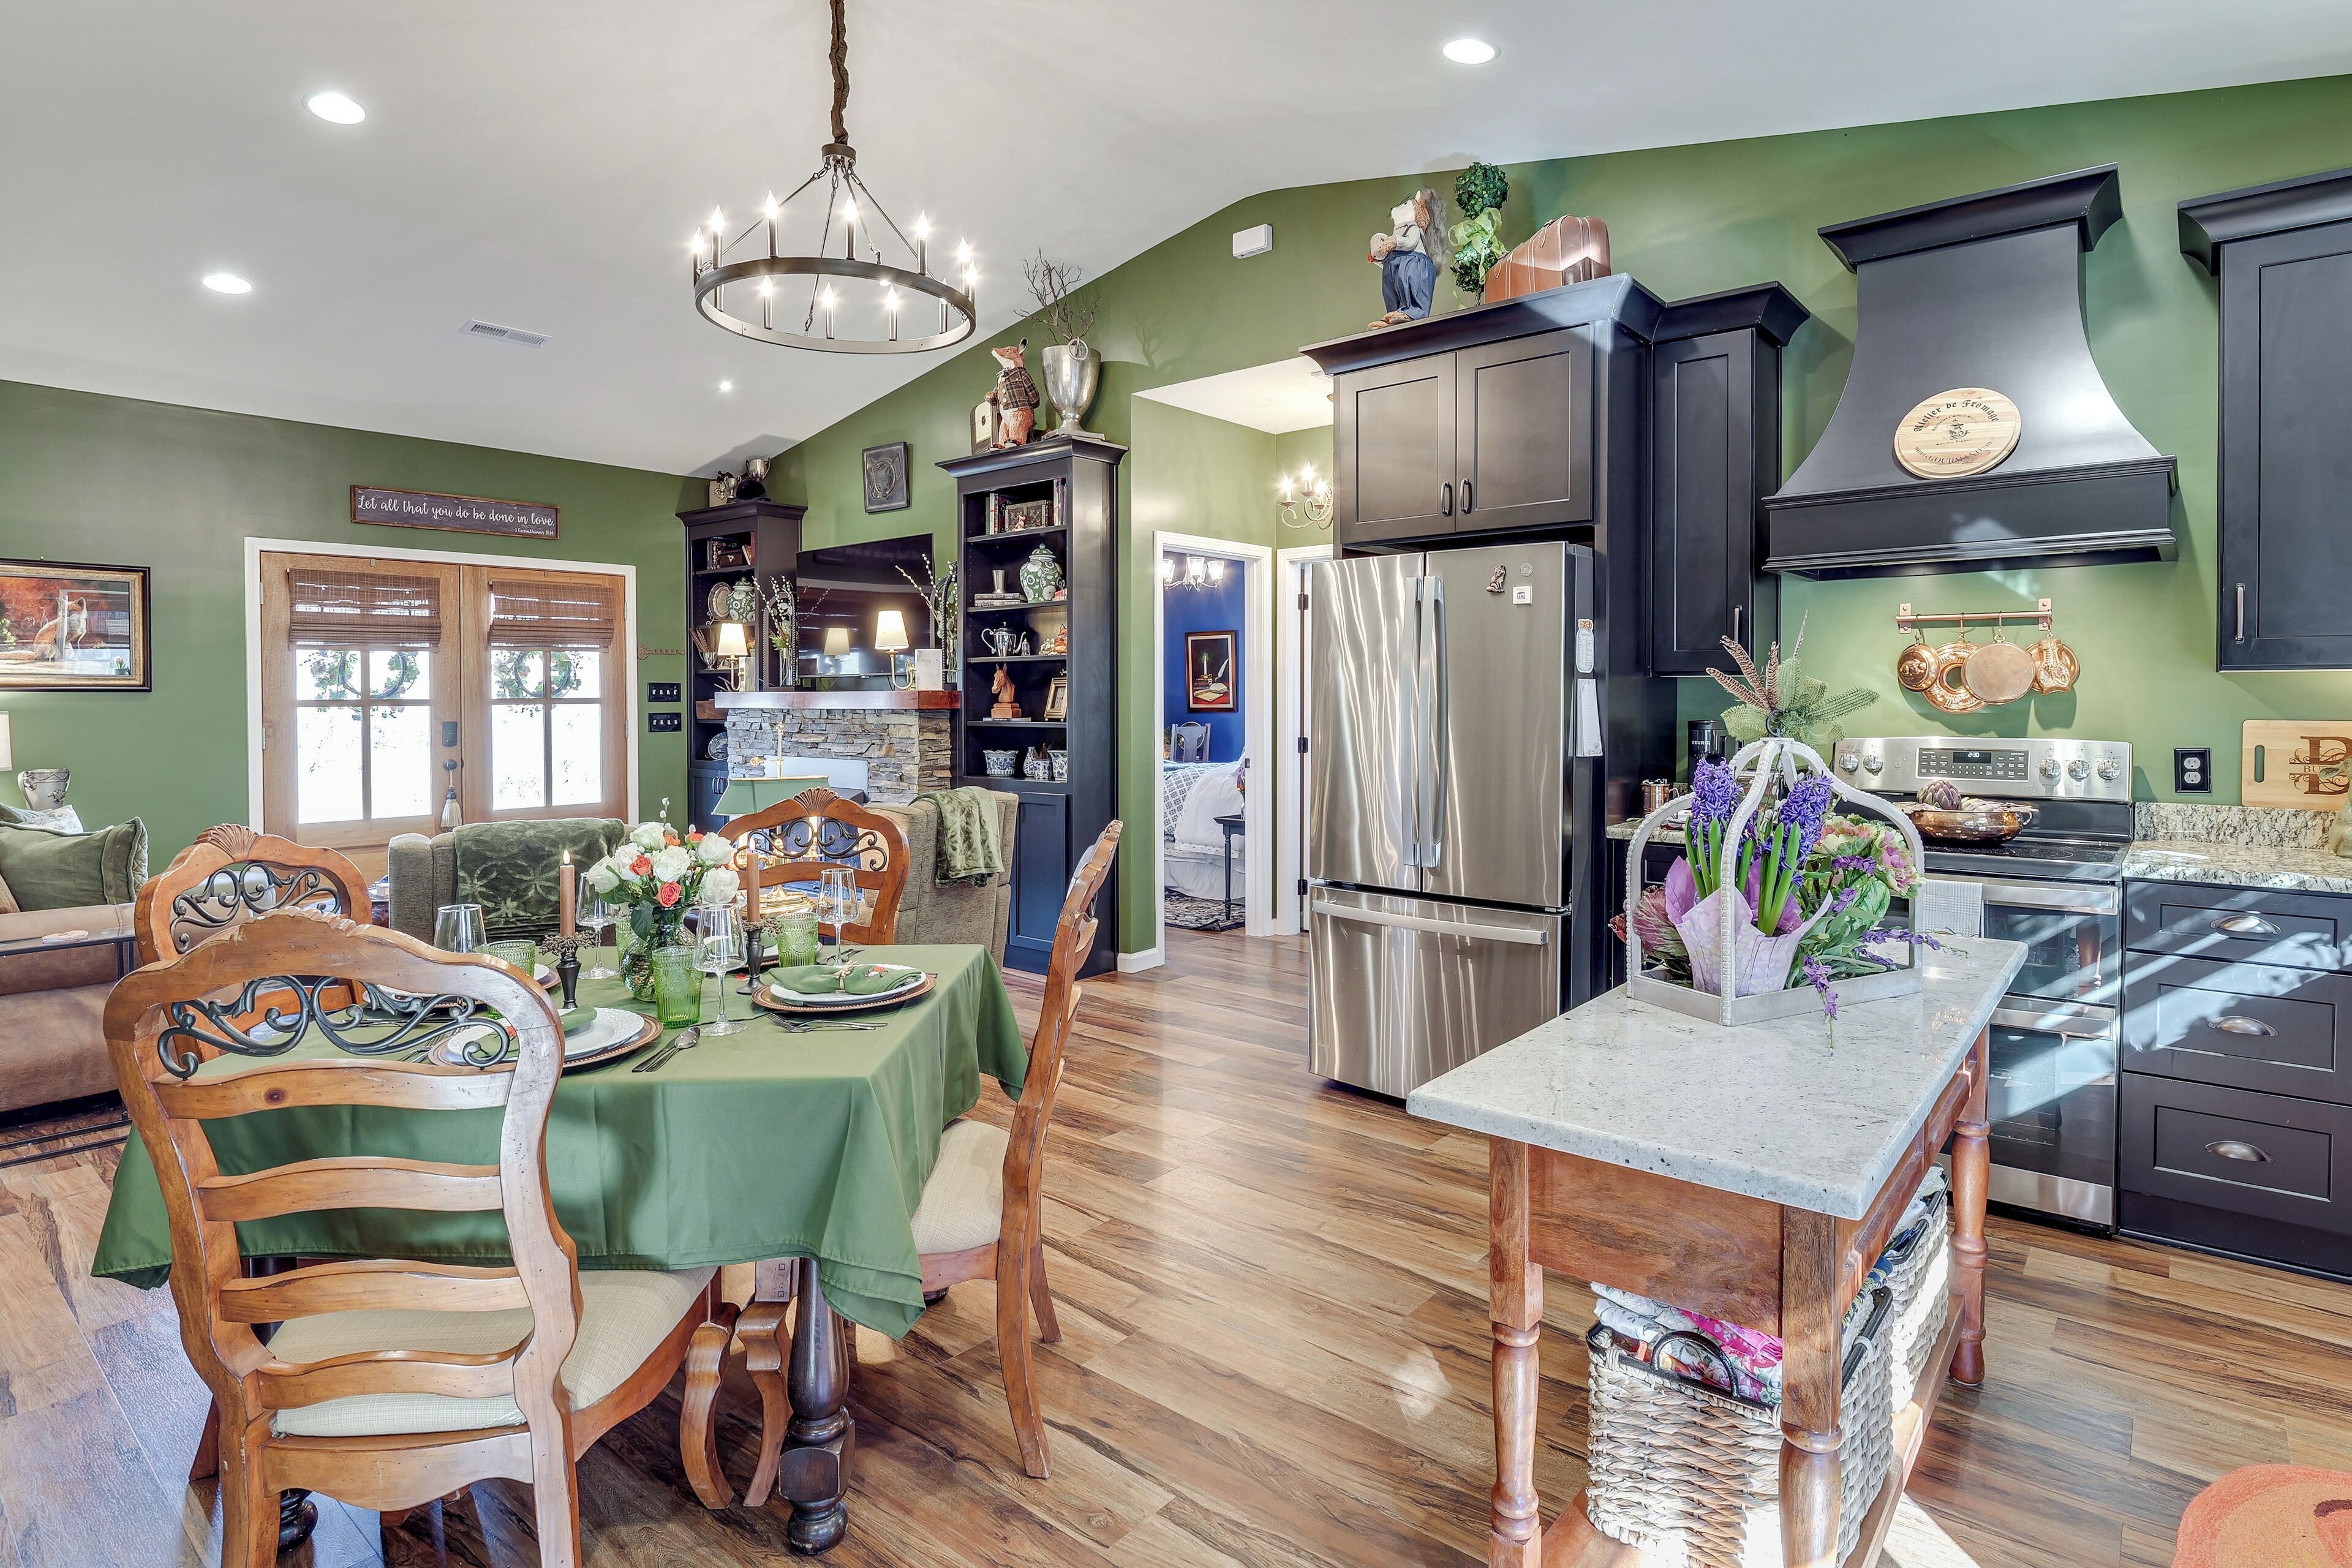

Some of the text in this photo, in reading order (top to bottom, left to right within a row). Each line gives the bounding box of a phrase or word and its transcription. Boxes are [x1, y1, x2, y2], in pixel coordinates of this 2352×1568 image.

[1913, 407, 1942, 432] Atelier
[1962, 400, 1999, 423] Fromage
[358, 495, 555, 526] Let all that you do be done in love.
